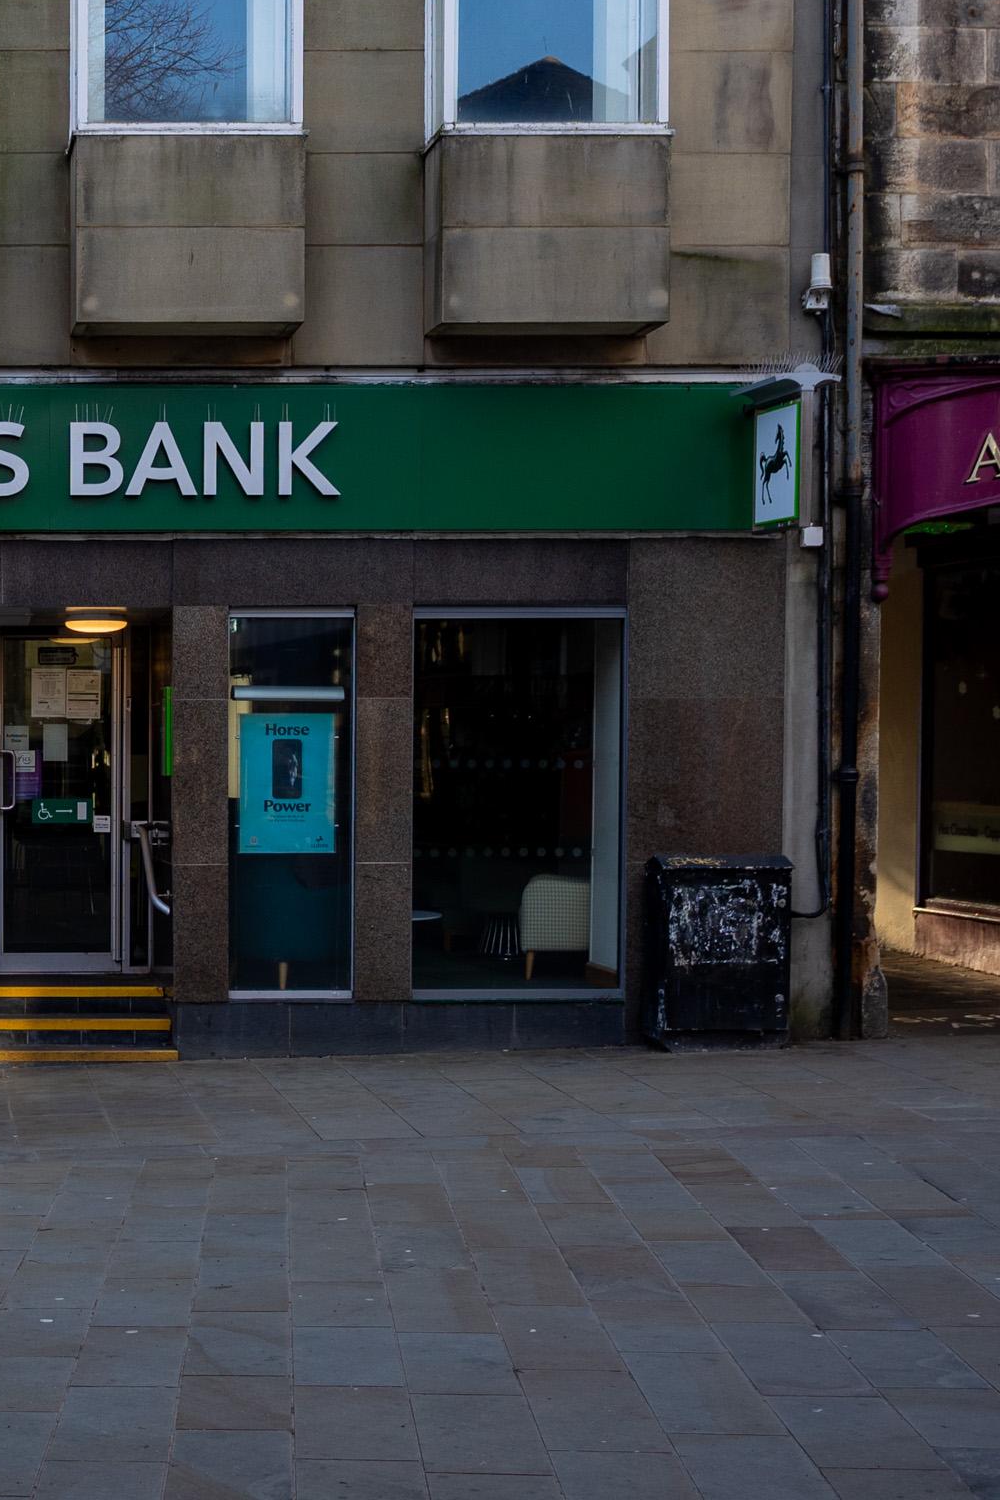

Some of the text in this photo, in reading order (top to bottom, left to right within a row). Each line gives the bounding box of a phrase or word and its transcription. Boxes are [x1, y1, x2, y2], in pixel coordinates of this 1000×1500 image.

[69, 420, 341, 497] BANK
[265, 723, 310, 736] Horse
[263, 799, 312, 813] Power
